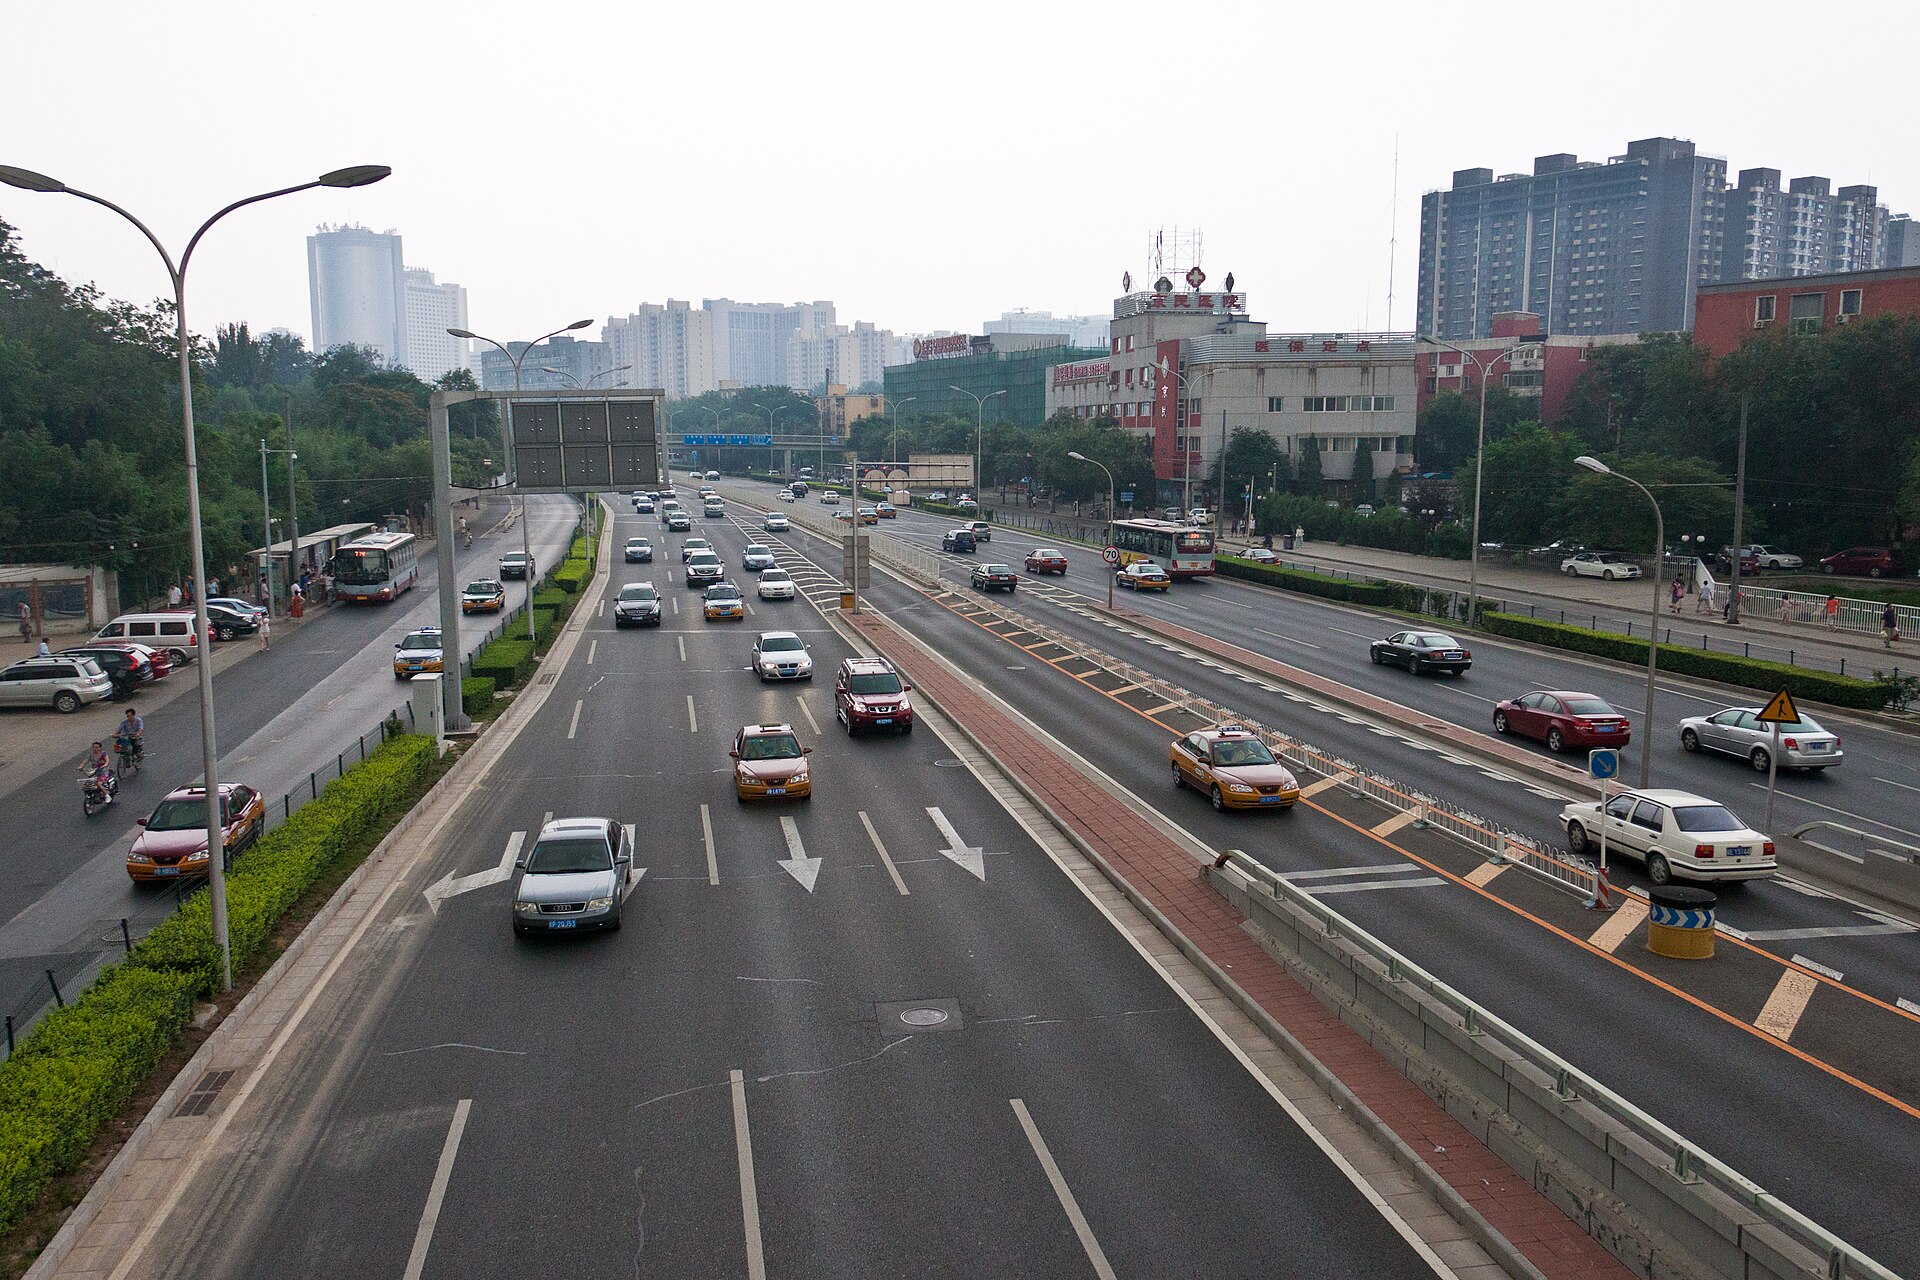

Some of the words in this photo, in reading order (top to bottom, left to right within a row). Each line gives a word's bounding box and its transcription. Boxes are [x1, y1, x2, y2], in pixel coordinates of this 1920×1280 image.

[1150, 294, 1241, 308] 京民医院
[1254, 340, 1370, 353] 医保定点
[1105, 550, 1118, 559] 70
